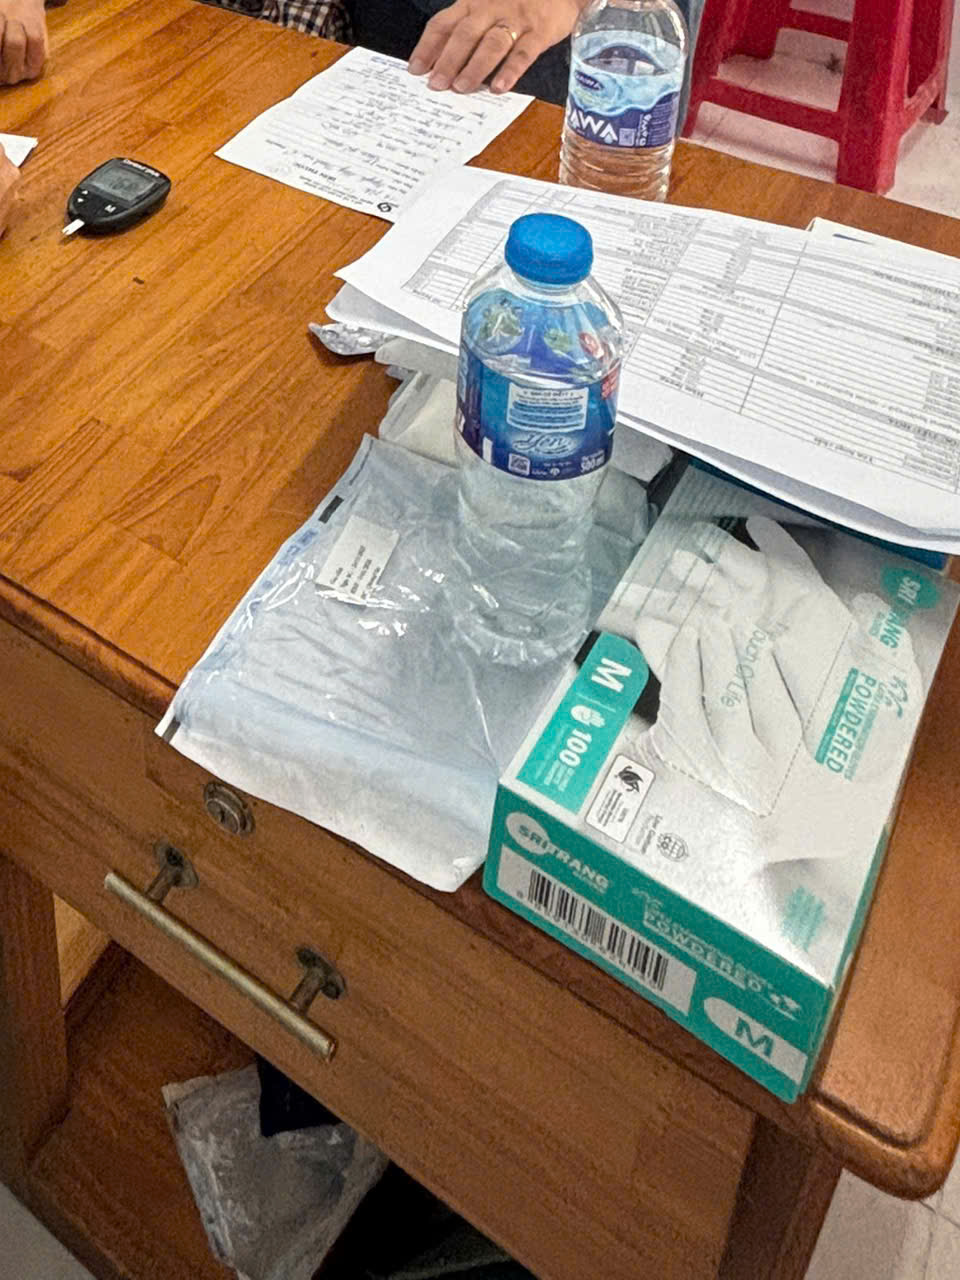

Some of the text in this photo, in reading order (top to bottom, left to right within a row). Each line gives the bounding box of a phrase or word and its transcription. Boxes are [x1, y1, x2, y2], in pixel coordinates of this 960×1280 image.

[591, 657, 632, 693] M
[559, 728, 593, 768] 100
[826, 671, 877, 774] POWDERED
[518, 824, 609, 889] SRITRANG
[646, 908, 763, 993] POWDERED
[735, 1016, 775, 1058] M
